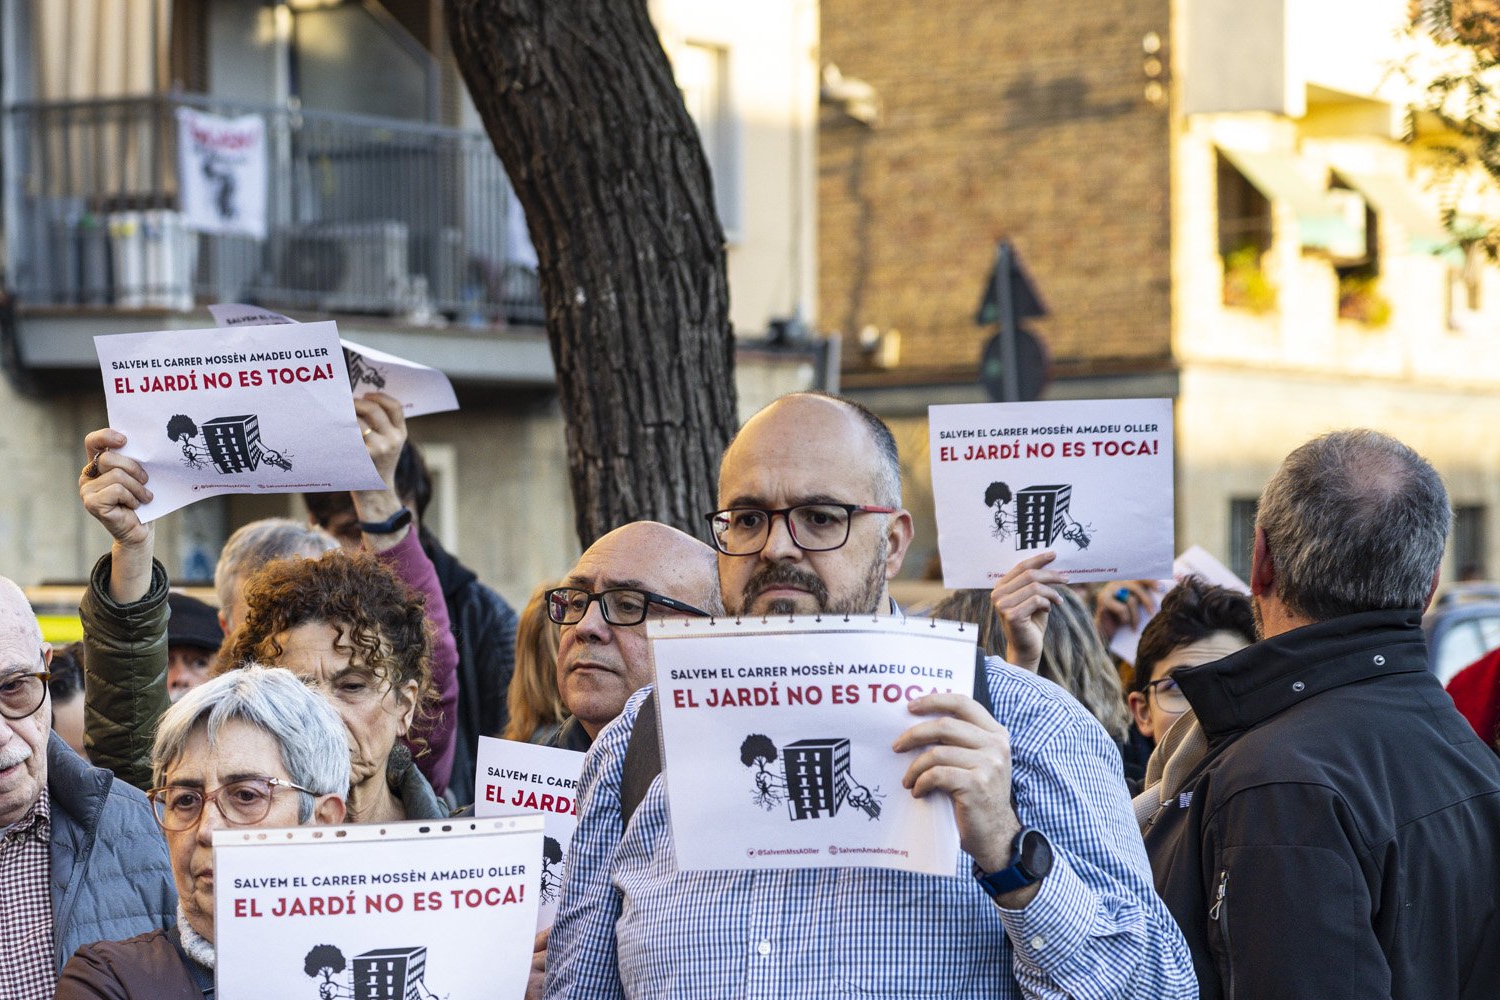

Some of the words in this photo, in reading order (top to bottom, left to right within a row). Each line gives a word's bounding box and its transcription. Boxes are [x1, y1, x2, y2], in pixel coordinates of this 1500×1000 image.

[112, 360, 148, 369] SALVEM
[151, 359, 161, 367] EL
[164, 357, 202, 367] CARRER
[205, 353, 246, 365] MOSSÈN
[250, 351, 291, 362] AMADEU
[295, 348, 328, 358] OLLER
[114, 376, 135, 393] EL
[139, 370, 198, 393] JARDÍ
[202, 371, 233, 389] NO
[237, 369, 263, 387] ES
[267, 362, 334, 384] TOCA!
[940, 430, 974, 439] SALVEM
[978, 429, 987, 437] EL
[990, 428, 1028, 436] CARRER
[1031, 424, 1073, 435] MOSSÈN
[1076, 425, 1121, 434] AMADEU
[1124, 424, 1158, 433] OLLER
[939, 446, 959, 463] EL
[963, 440, 1020, 460] JARDÍ
[1025, 441, 1056, 458] NO
[1061, 441, 1086, 457] ES
[1092, 439, 1159, 456] TOCA!
[671, 669, 717, 680] SALVEM
[721, 668, 734, 678] EL
[738, 666, 787, 677] CARRER
[791, 662, 844, 676] MOSSÈN
[848, 664, 906, 675] AMADEU
[910, 665, 953, 679] OLLER
[672, 688, 699, 708] EL
[706, 682, 779, 707] JARDÍ
[786, 685, 823, 704] NO
[831, 683, 861, 704] ES
[487, 767, 528, 782] SALVEM
[531, 774, 543, 784] EL
[485, 784, 505, 803] EL
[234, 878, 287, 888] SALVEM
[293, 877, 307, 887] EL
[312, 875, 366, 886] CARRER
[372, 870, 425, 884] MOSSÈN
[431, 868, 483, 881] AMADEU
[488, 865, 525, 877] OLLER
[233, 897, 263, 918] EL
[271, 890, 356, 917] JARDÍ
[365, 893, 404, 912] NO
[412, 890, 443, 911] ES
[450, 883, 525, 909] TOCA!
